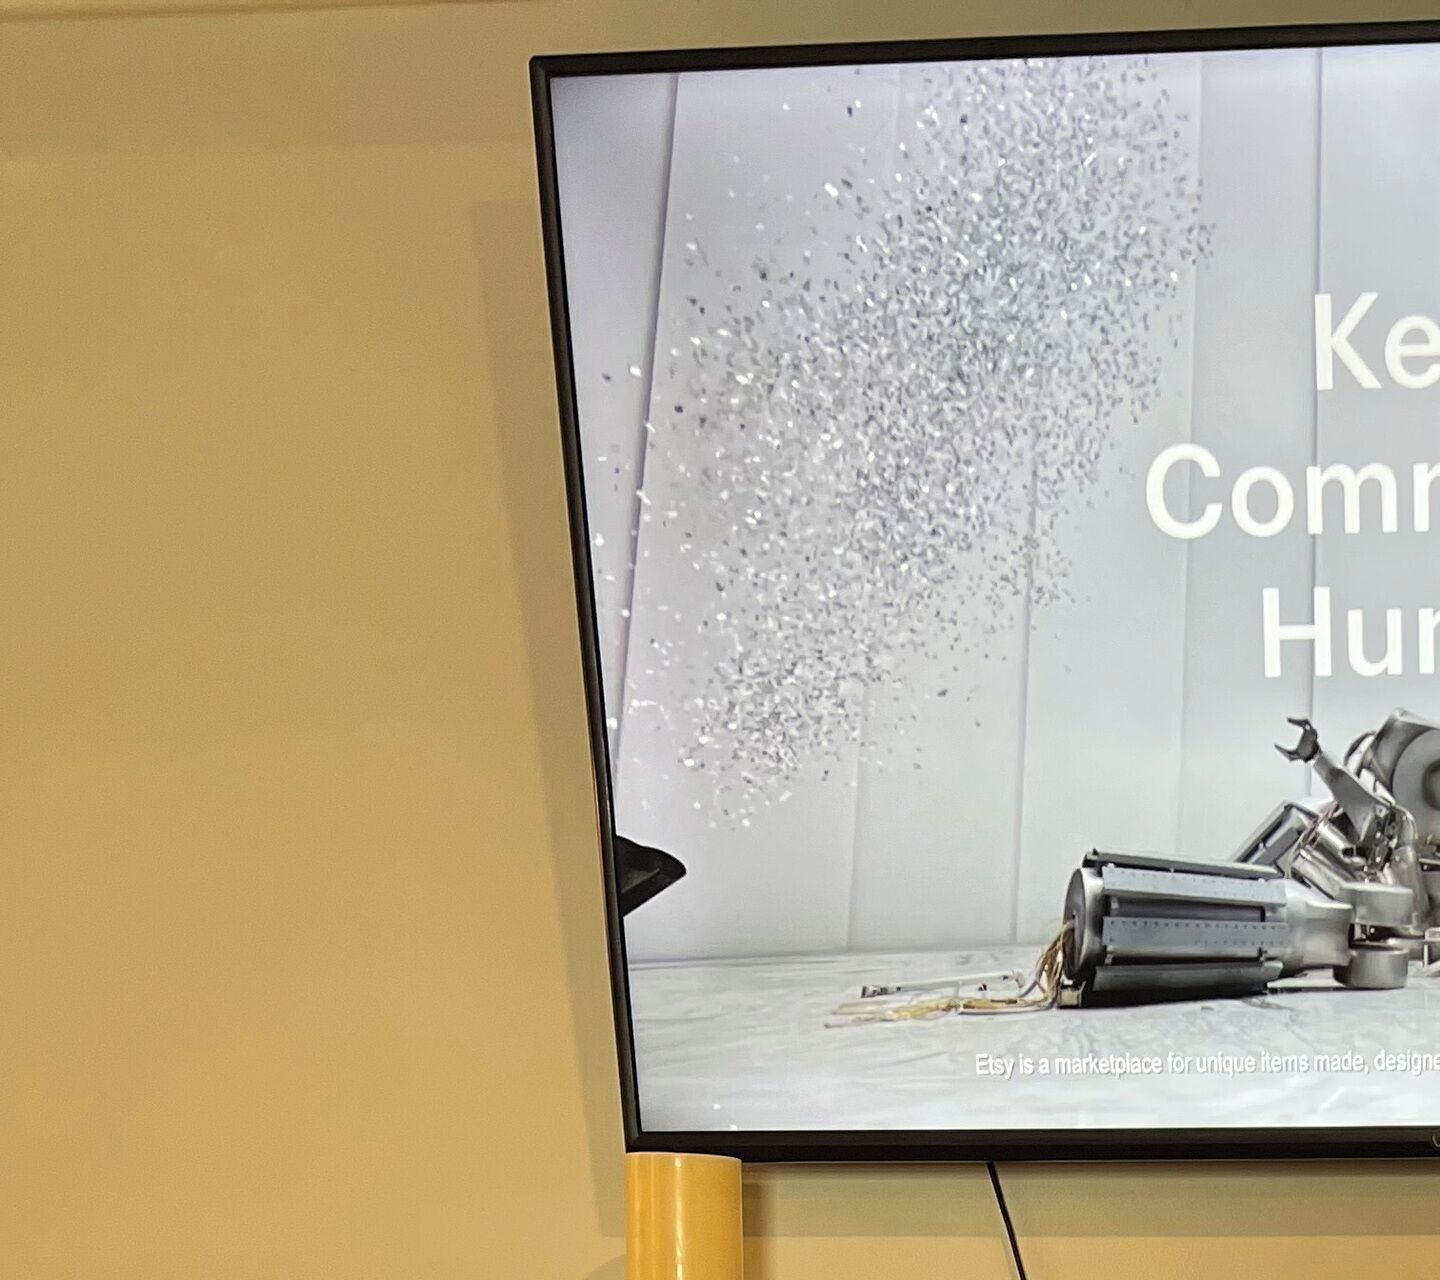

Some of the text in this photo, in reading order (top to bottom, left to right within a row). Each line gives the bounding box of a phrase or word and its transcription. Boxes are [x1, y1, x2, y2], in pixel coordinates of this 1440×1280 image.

[975, 1052, 1015, 1079] Etsy
[1019, 1053, 1035, 1075] is
[1038, 1058, 1050, 1074] a
[1054, 1053, 1163, 1078] marketplace
[1167, 1053, 1193, 1074] for
[1196, 1053, 1257, 1077] unique
[1261, 1051, 1309, 1073] items
[1313, 1051, 1369, 1074] made,
